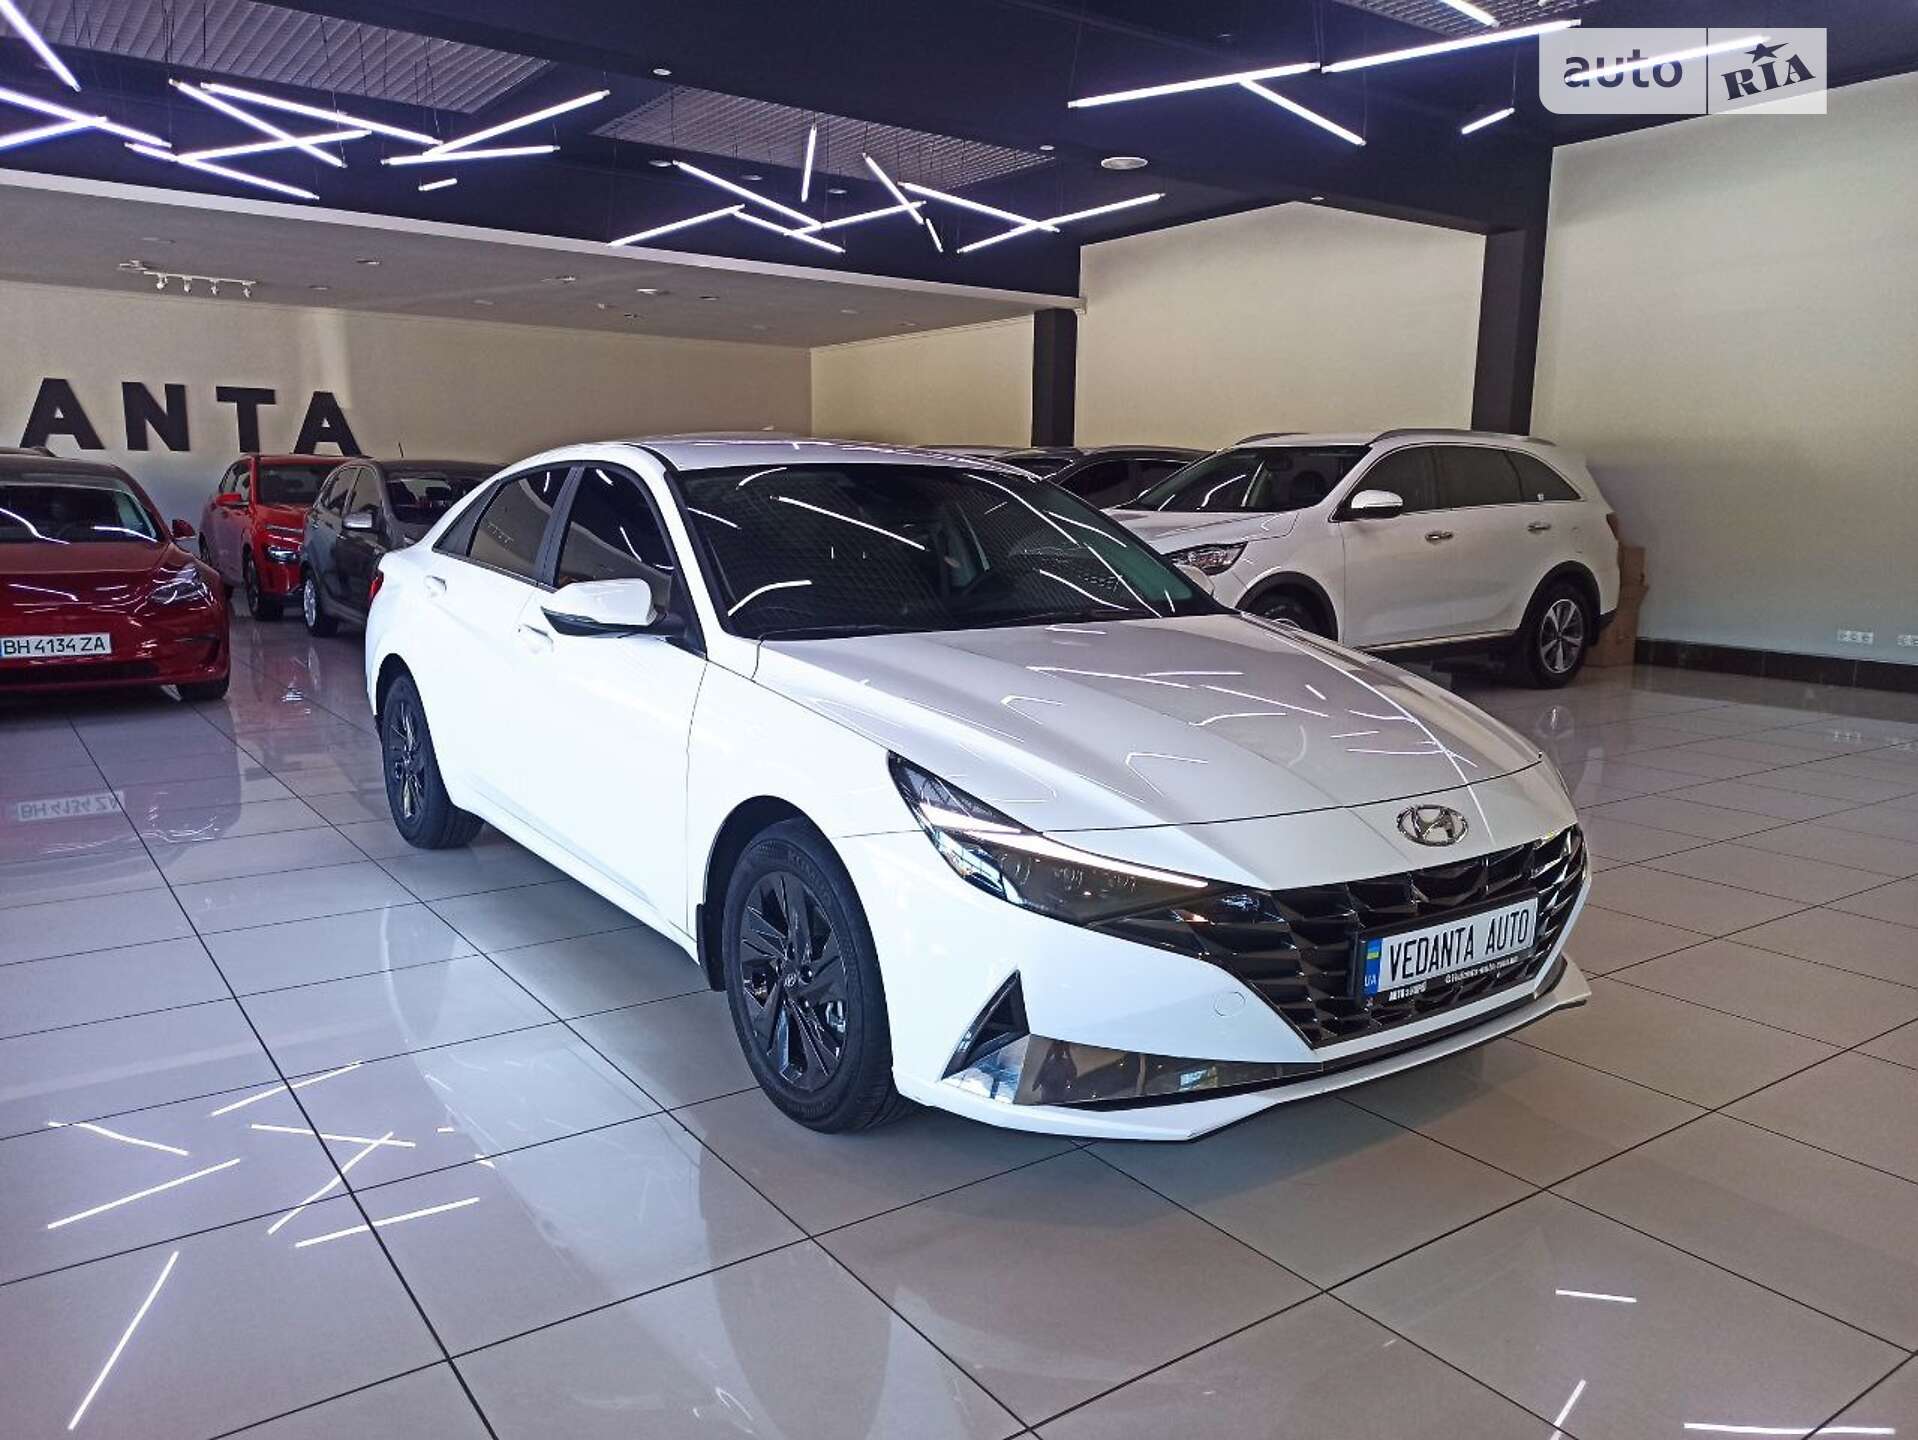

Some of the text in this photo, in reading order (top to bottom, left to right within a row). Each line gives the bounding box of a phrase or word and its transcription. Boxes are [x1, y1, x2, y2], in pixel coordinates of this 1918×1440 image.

[19, 377, 363, 455] ANTA
[3, 636, 106, 655] BH 4134 ZA
[1390, 924, 1474, 982] VEDANTA
[1485, 908, 1530, 956] AUTO
[1364, 974, 1377, 987] UA
